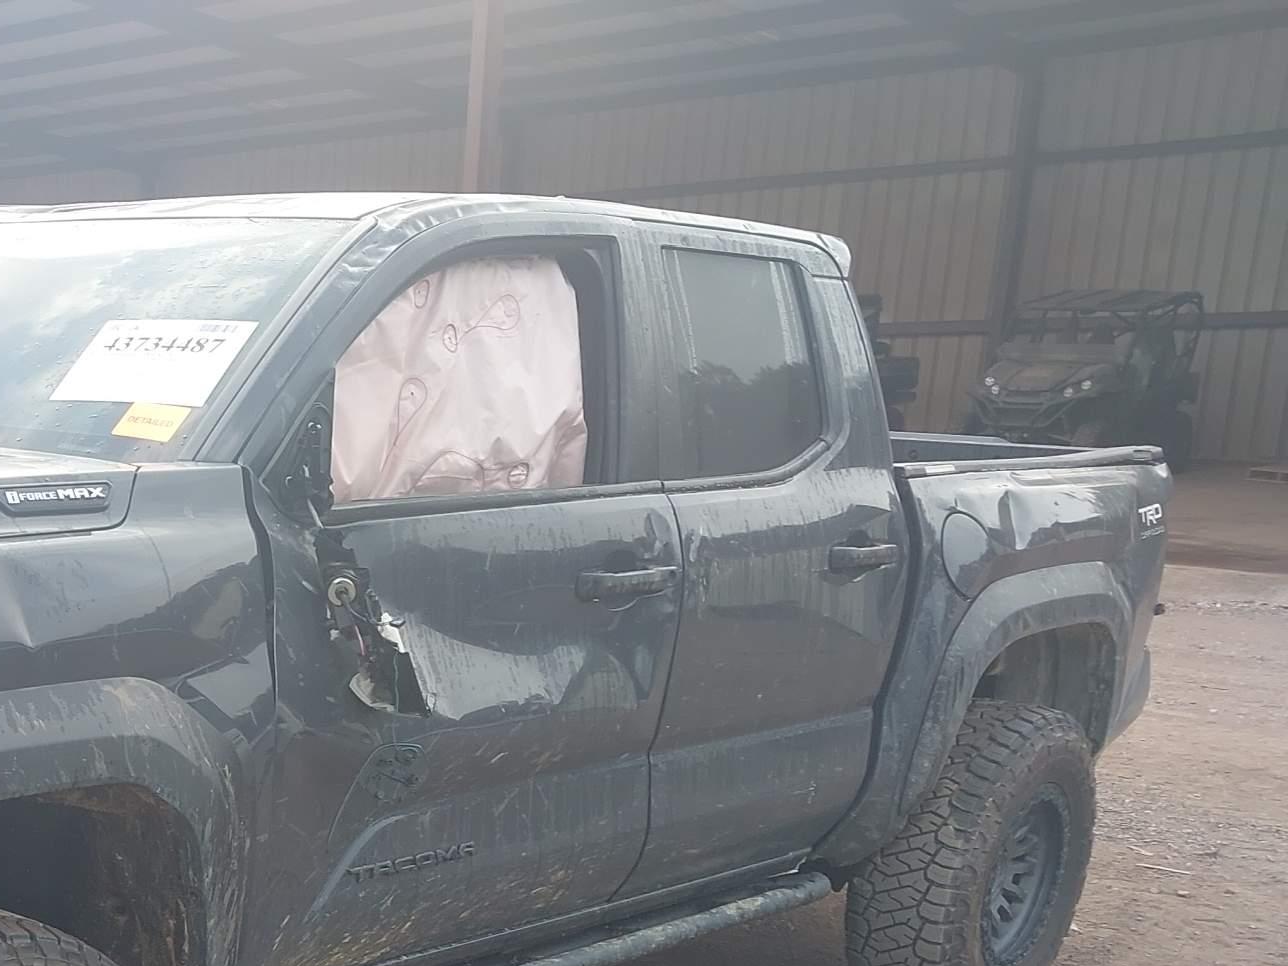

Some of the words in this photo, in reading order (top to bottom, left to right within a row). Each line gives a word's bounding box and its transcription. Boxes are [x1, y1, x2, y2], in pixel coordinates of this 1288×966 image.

[103, 336, 227, 354] 43734487
[126, 414, 175, 429] DETAILED
[1138, 503, 1163, 526] TRD
[345, 841, 475, 885] TACOMA
